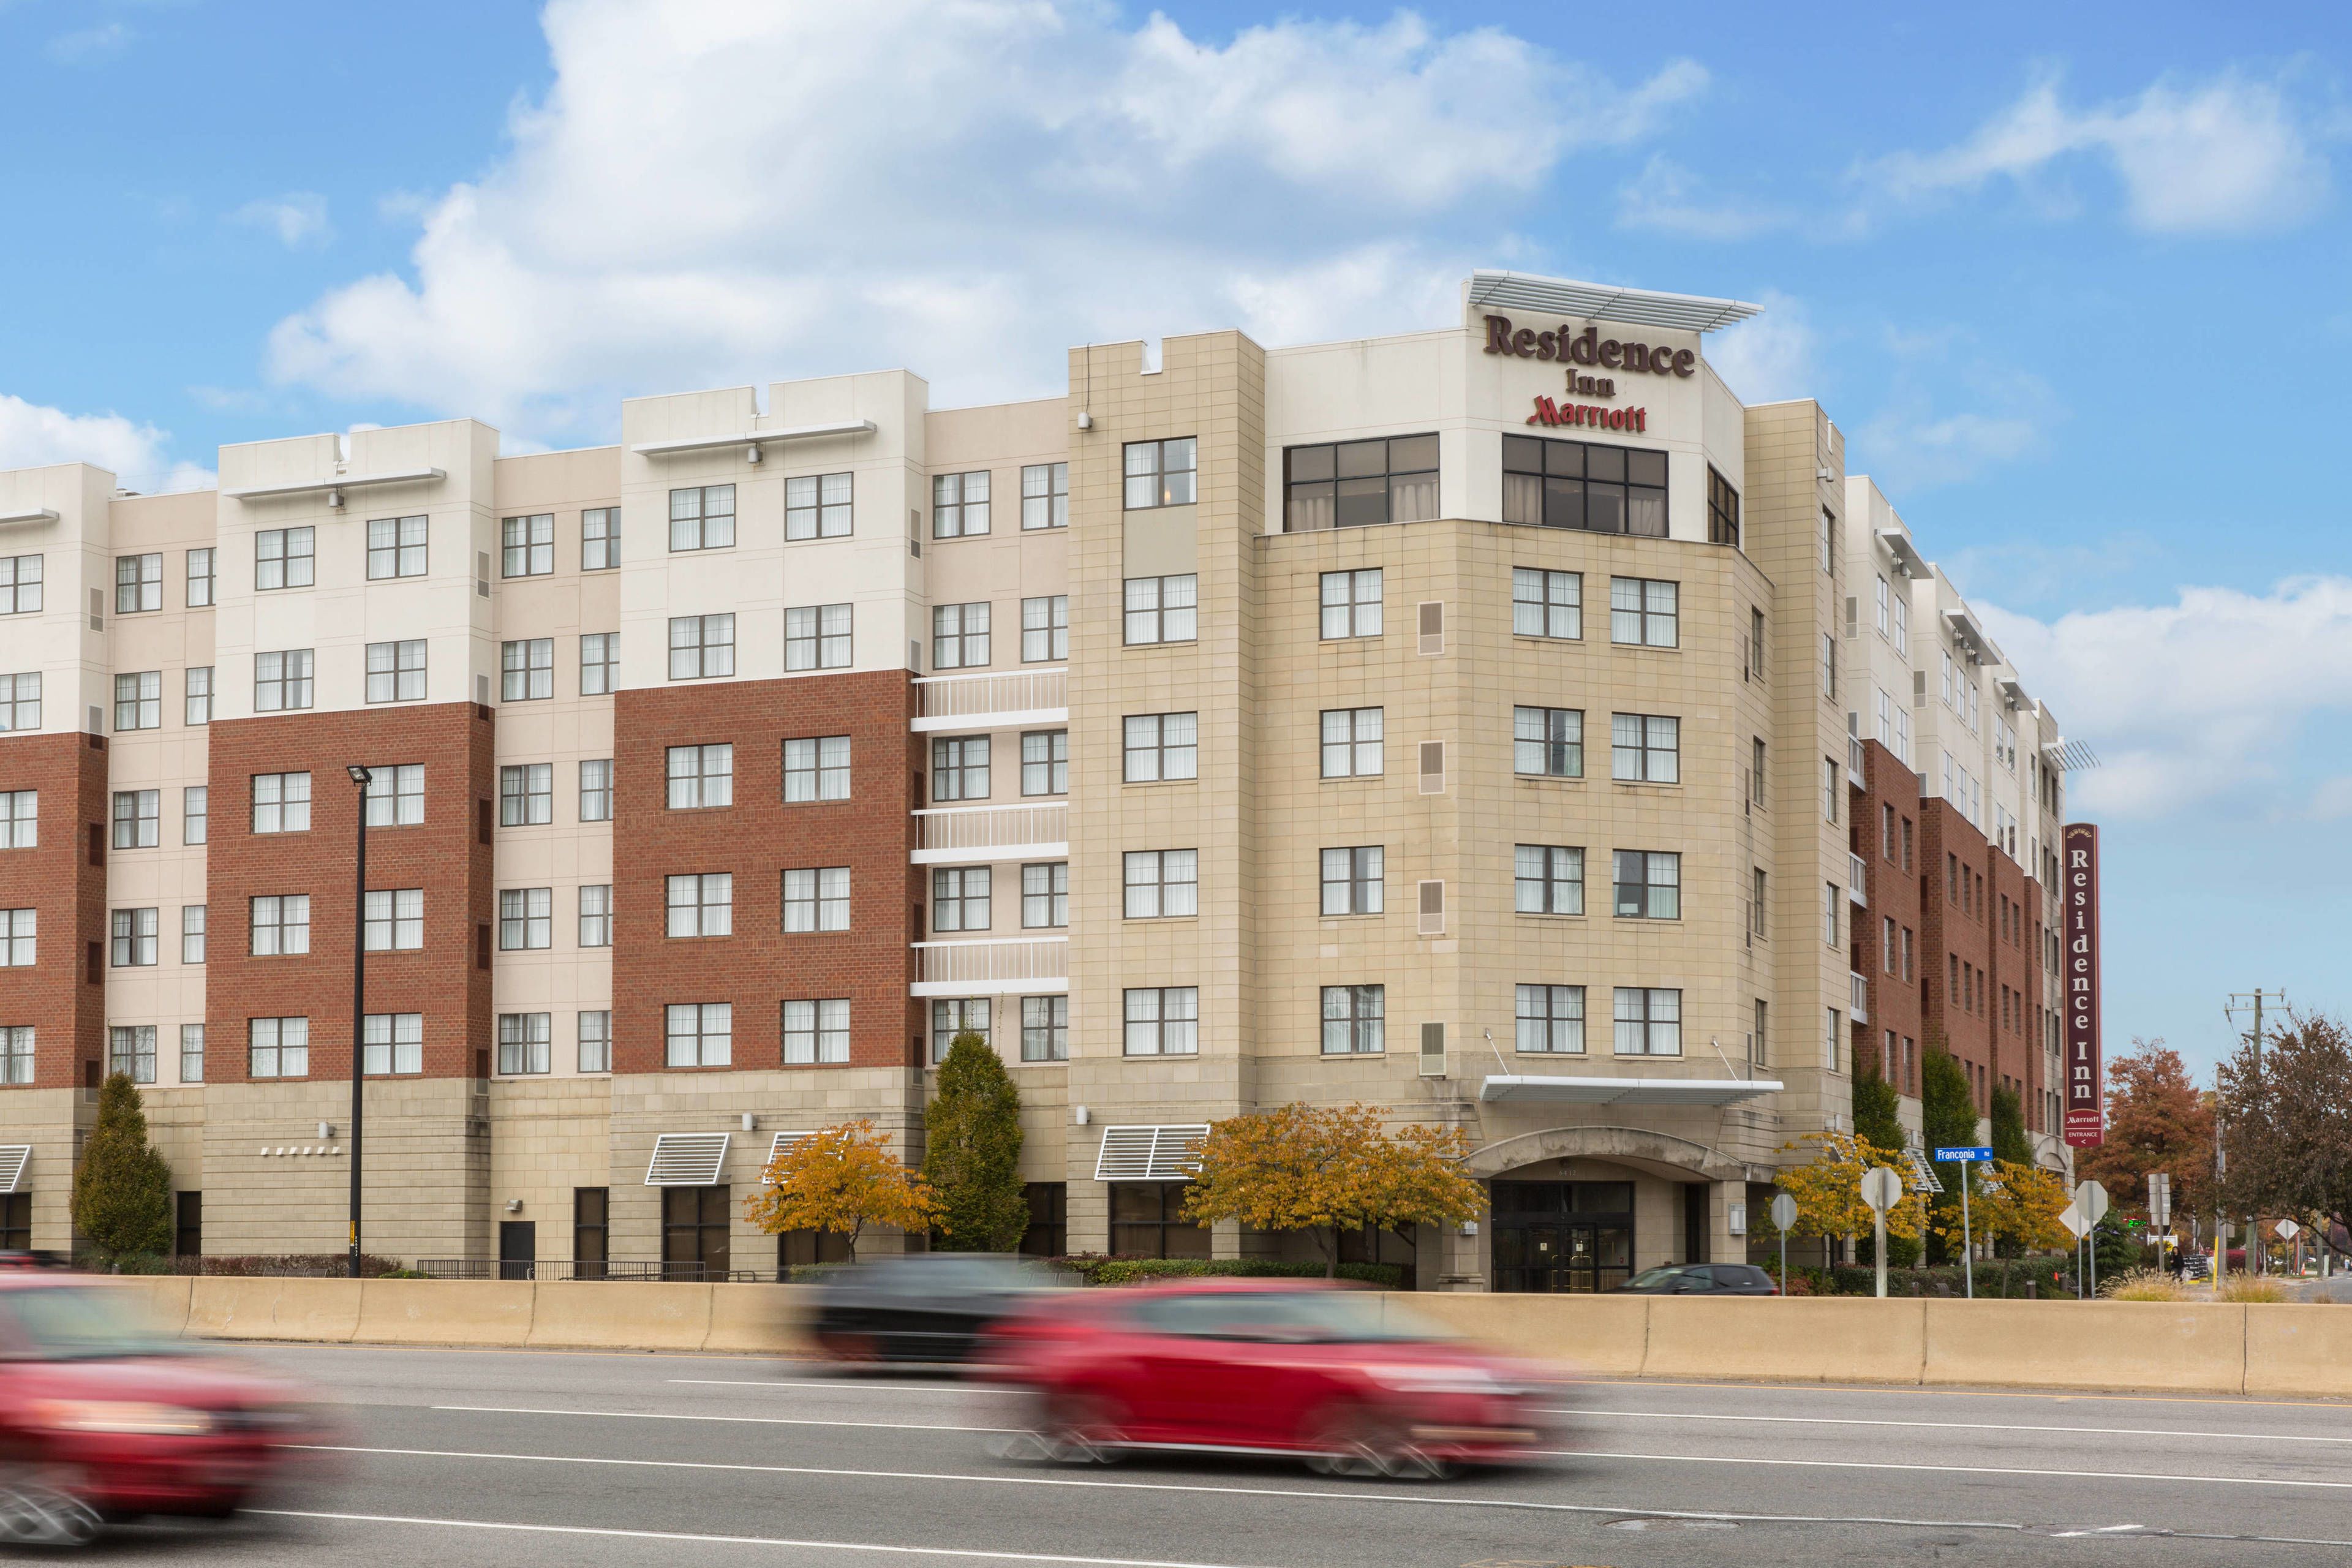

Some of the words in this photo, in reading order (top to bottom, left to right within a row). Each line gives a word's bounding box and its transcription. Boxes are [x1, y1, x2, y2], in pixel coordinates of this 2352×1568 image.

[1483, 314, 1695, 377] Residence
[1566, 368, 1616, 397] Inn
[1526, 395, 1647, 432] Marriott
[2070, 850, 2089, 1029] Residence
[2073, 1041, 2092, 1098] Inn
[1937, 1149, 1975, 1159] Franconia
